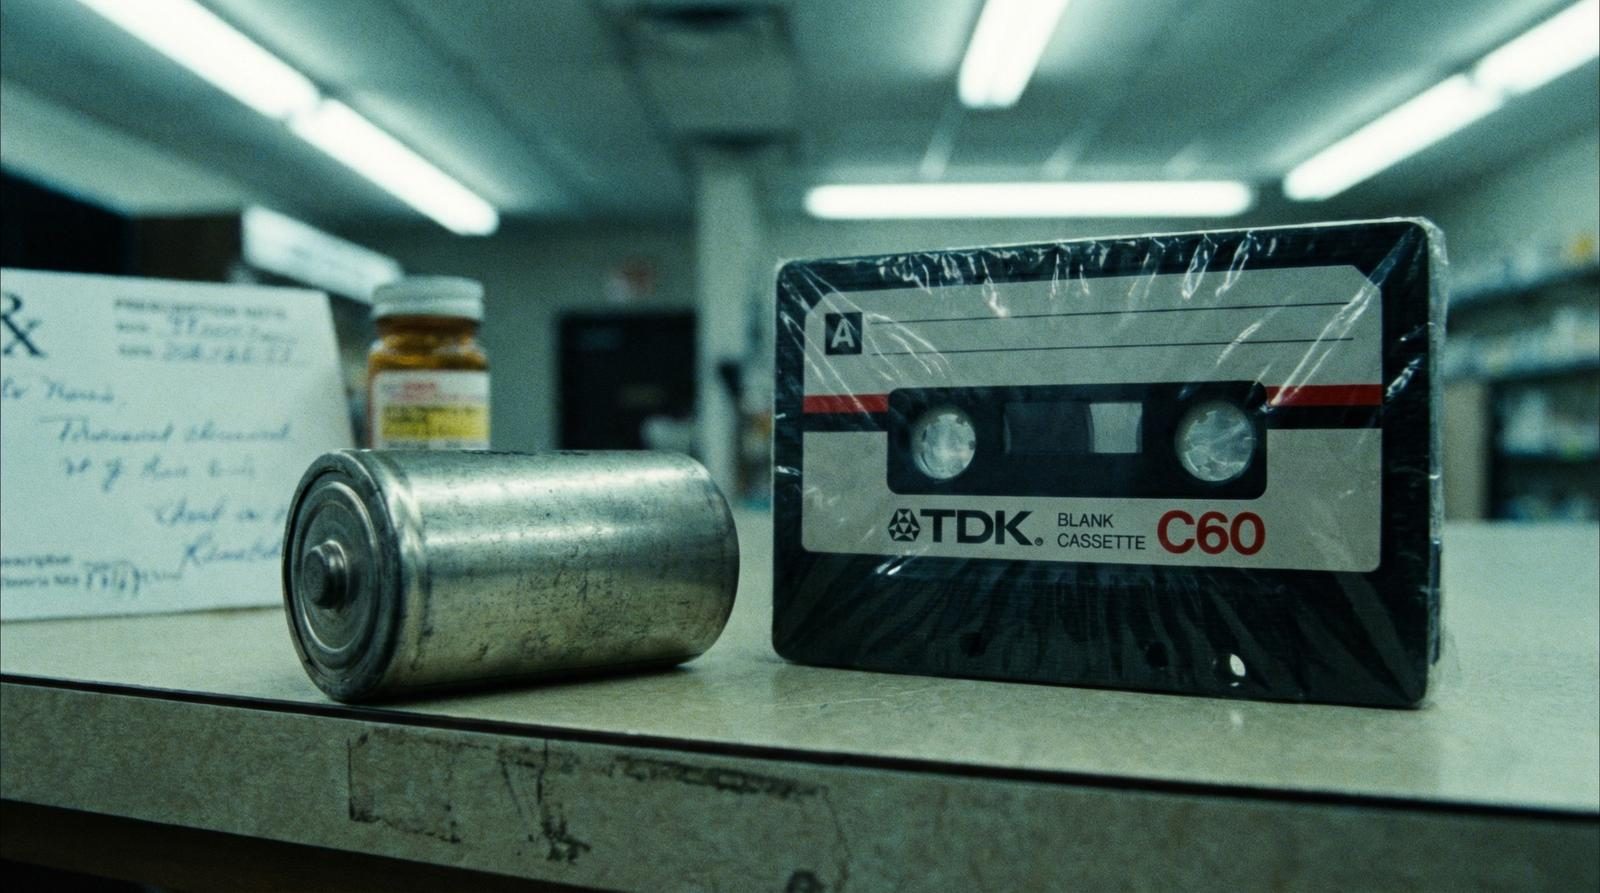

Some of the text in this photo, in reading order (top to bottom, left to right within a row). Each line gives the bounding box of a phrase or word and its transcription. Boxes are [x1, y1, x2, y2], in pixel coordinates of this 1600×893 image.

[831, 318, 855, 348] A
[1057, 513, 1114, 528] BLANK
[1057, 533, 1147, 550] CASSETTE
[1157, 509, 1266, 556] C60
